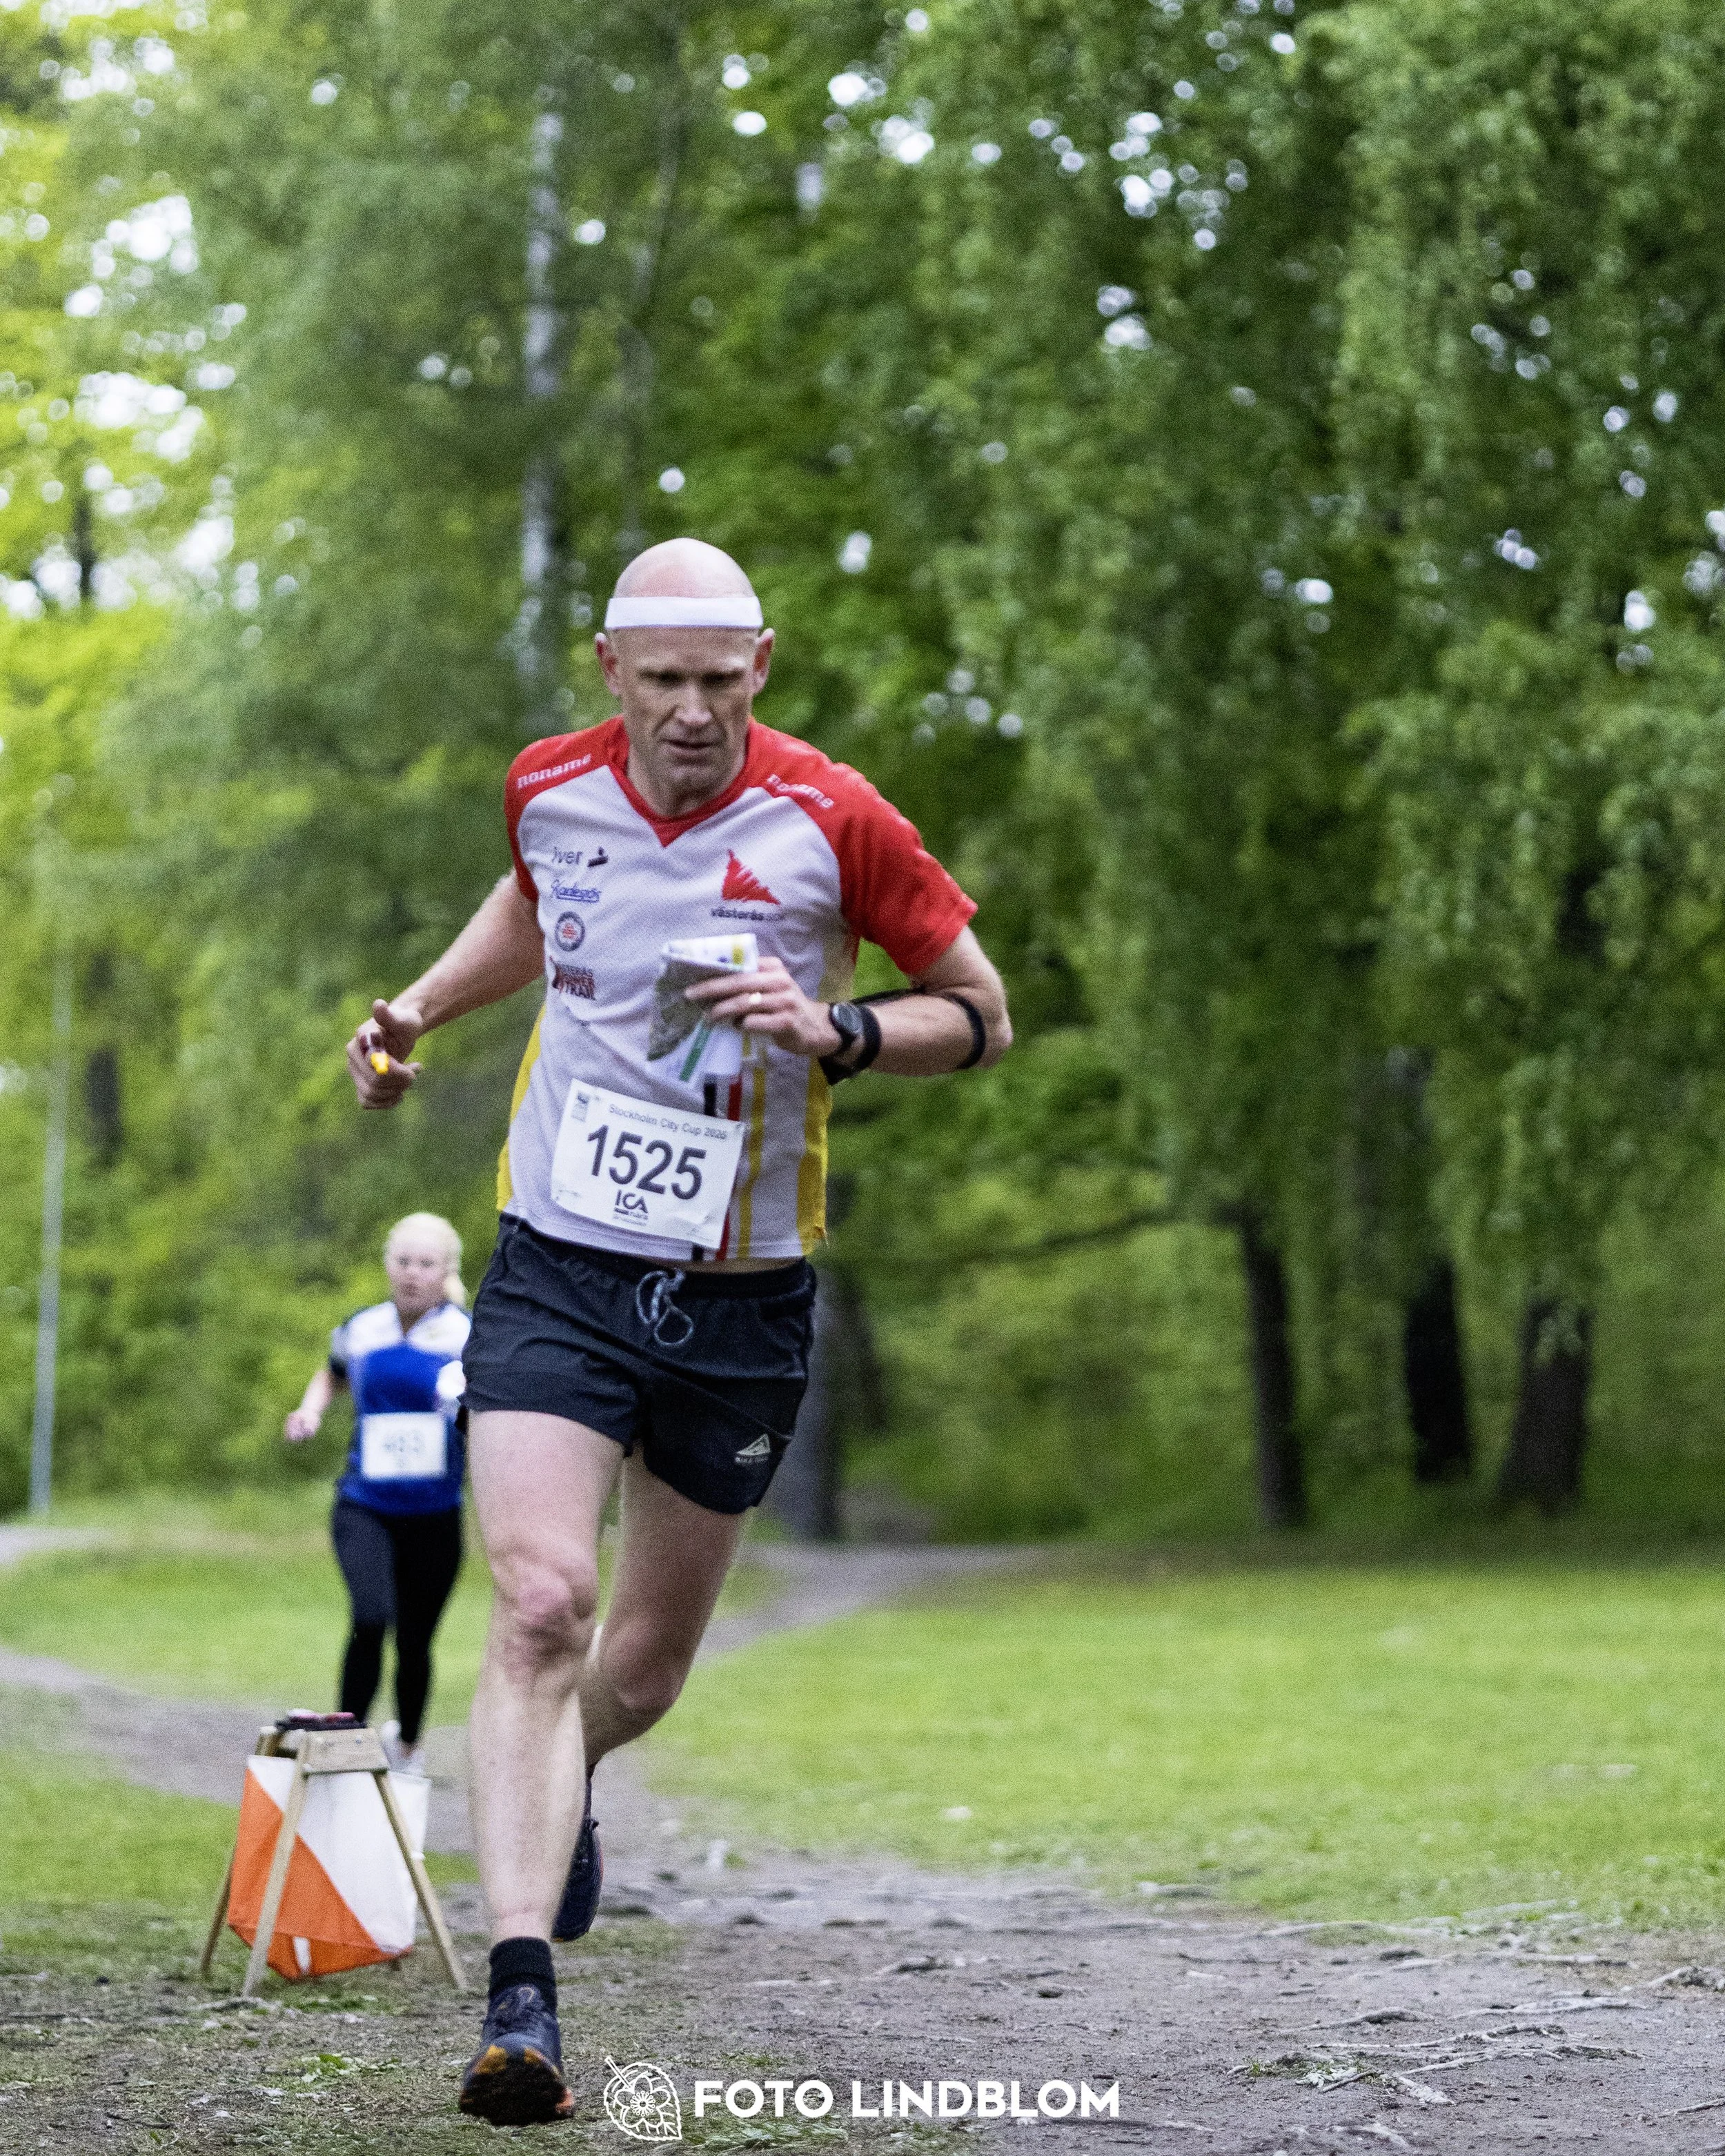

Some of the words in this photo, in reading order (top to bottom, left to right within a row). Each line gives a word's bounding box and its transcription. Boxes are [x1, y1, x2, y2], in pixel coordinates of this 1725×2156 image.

[516, 753, 591, 789] noname
[609, 1103, 657, 1125] Stockholm
[660, 1118, 678, 1132] City
[682, 1122, 702, 1136] Cup
[588, 1124, 707, 1200] 1525
[615, 1189, 649, 1214] ICA
